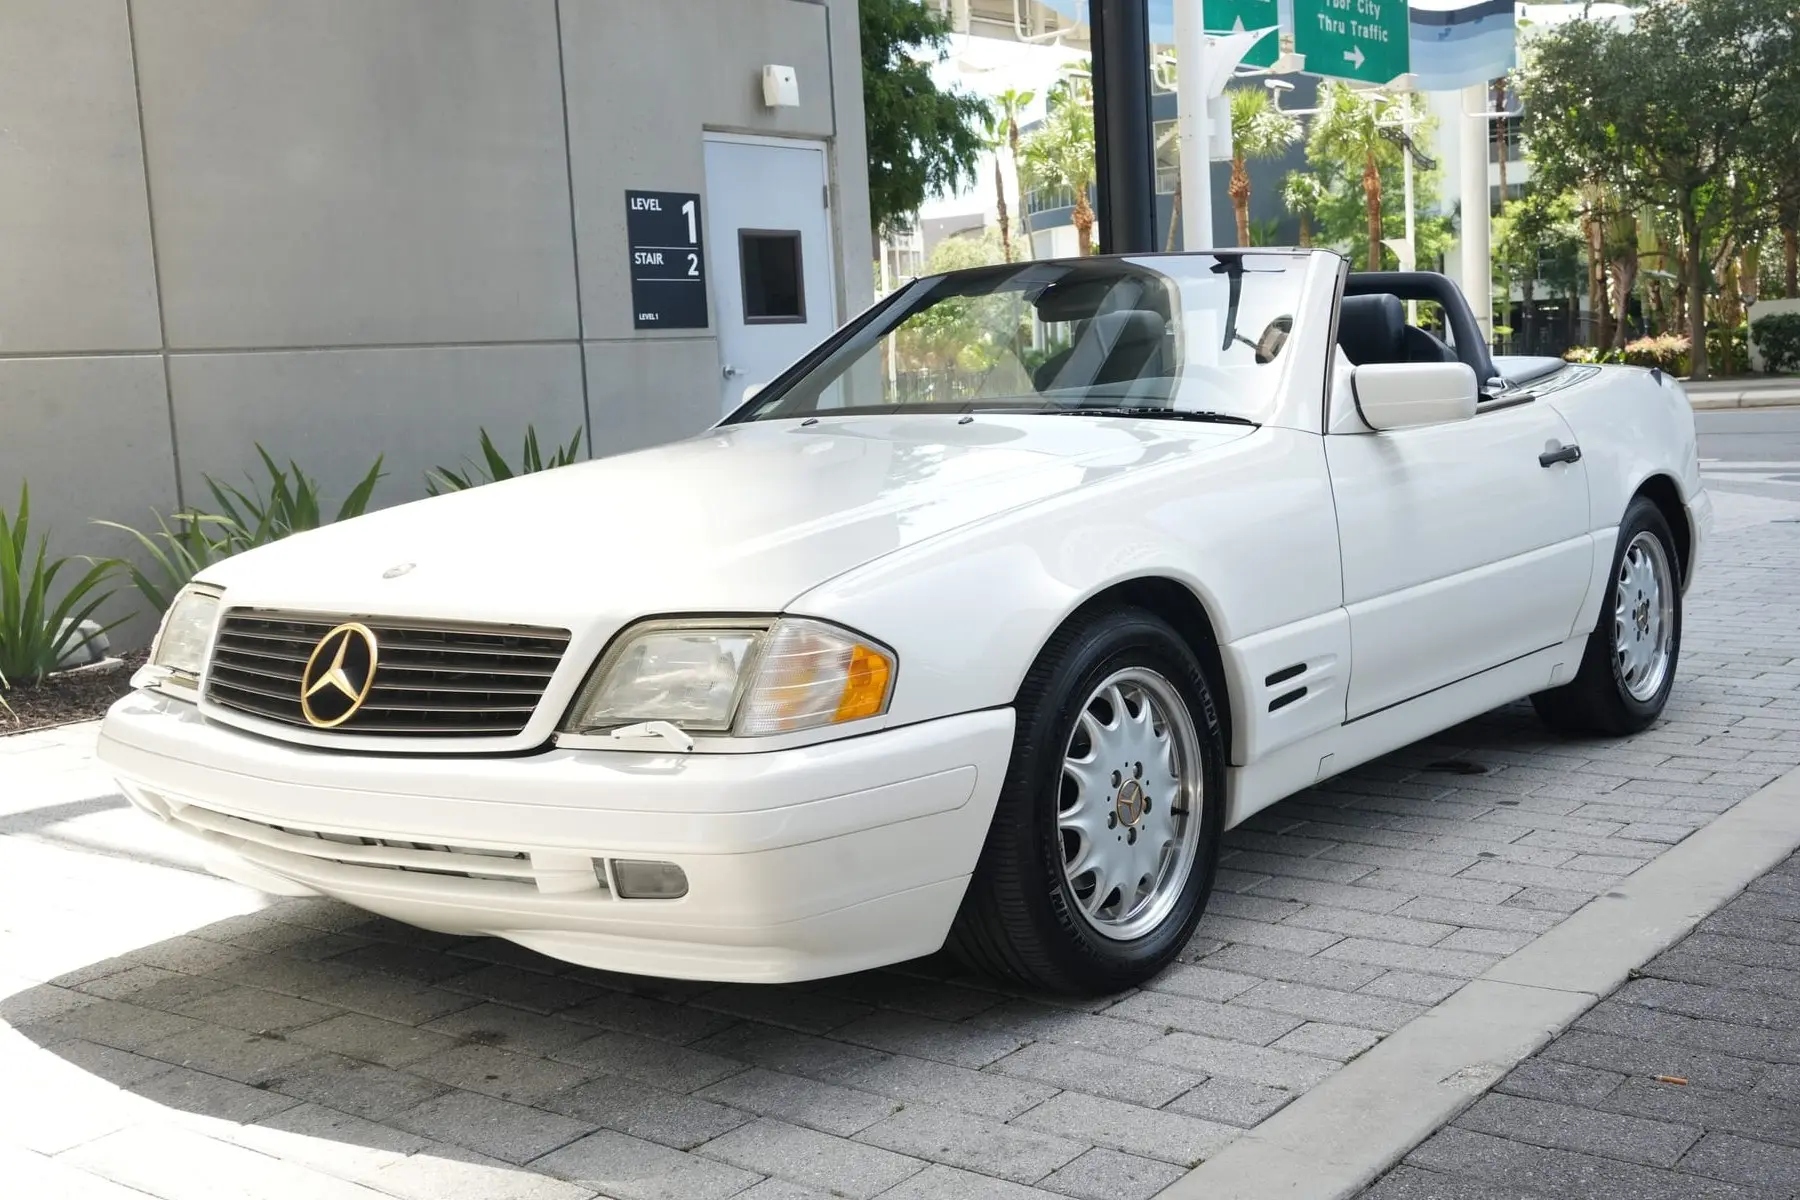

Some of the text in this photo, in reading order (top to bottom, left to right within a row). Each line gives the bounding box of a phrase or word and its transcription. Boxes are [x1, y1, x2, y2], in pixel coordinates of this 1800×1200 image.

[1357, 0, 1381, 20] City
[1317, 13, 1388, 42] Thru Traffic
[631, 197, 697, 244] LEVEL 1
[634, 252, 699, 276] STAIR 2
